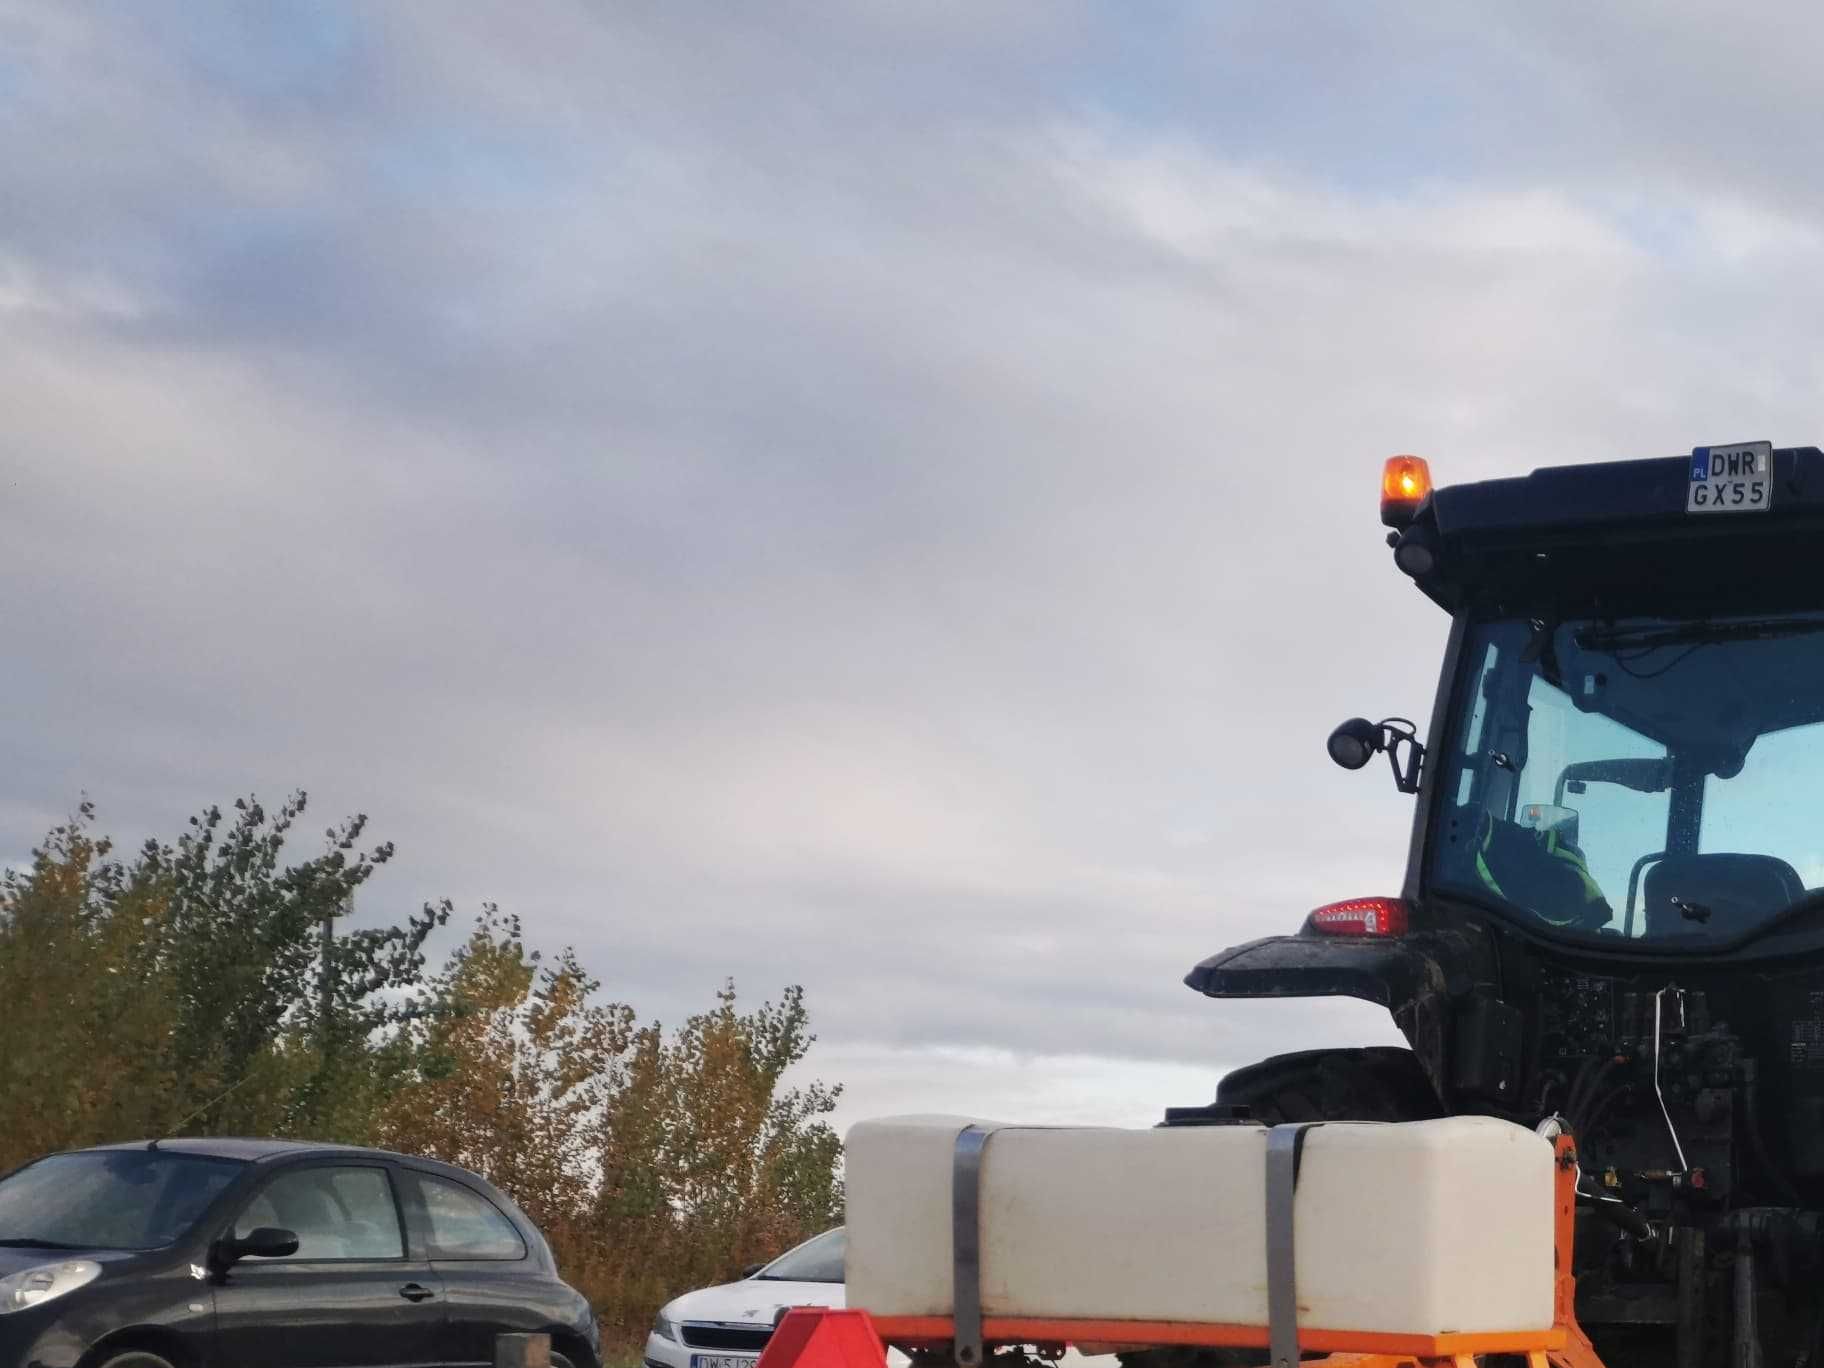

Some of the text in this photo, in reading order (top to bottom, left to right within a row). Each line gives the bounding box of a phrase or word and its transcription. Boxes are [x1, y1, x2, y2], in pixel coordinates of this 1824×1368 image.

[1693, 467, 1707, 479] PL
[1711, 451, 1755, 477] DWR
[1694, 481, 1764, 506] GX55
